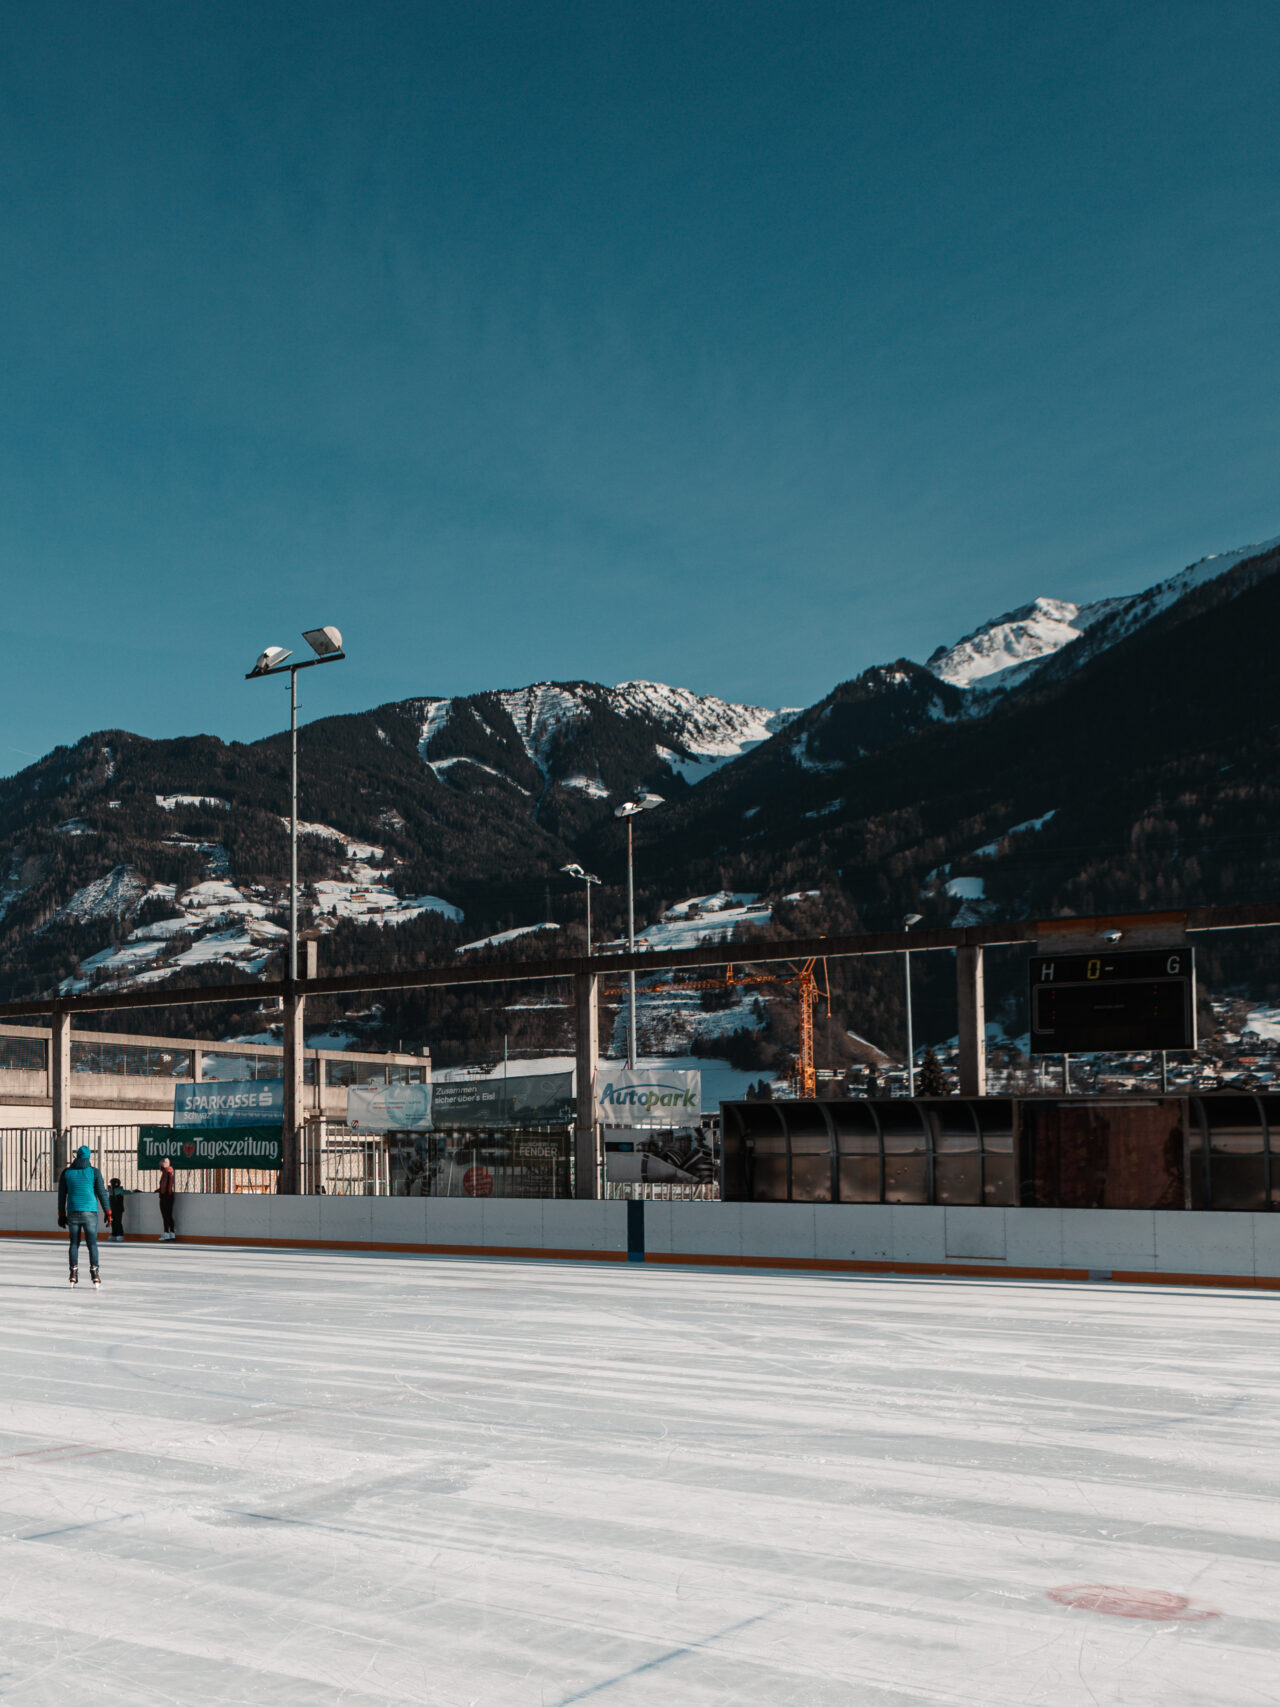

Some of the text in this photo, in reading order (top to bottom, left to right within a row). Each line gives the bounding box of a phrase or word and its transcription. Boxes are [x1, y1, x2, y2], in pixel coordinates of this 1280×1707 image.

[1040, 962, 1055, 981] H
[1166, 955, 1180, 974] G
[436, 1086, 477, 1096] Zusammen
[599, 1083, 697, 1112] Autopark
[185, 1094, 257, 1109] SPARKASSE
[143, 1136, 278, 1160] Tiroler Tageszeitung
[519, 1146, 558, 1157] FENDER
